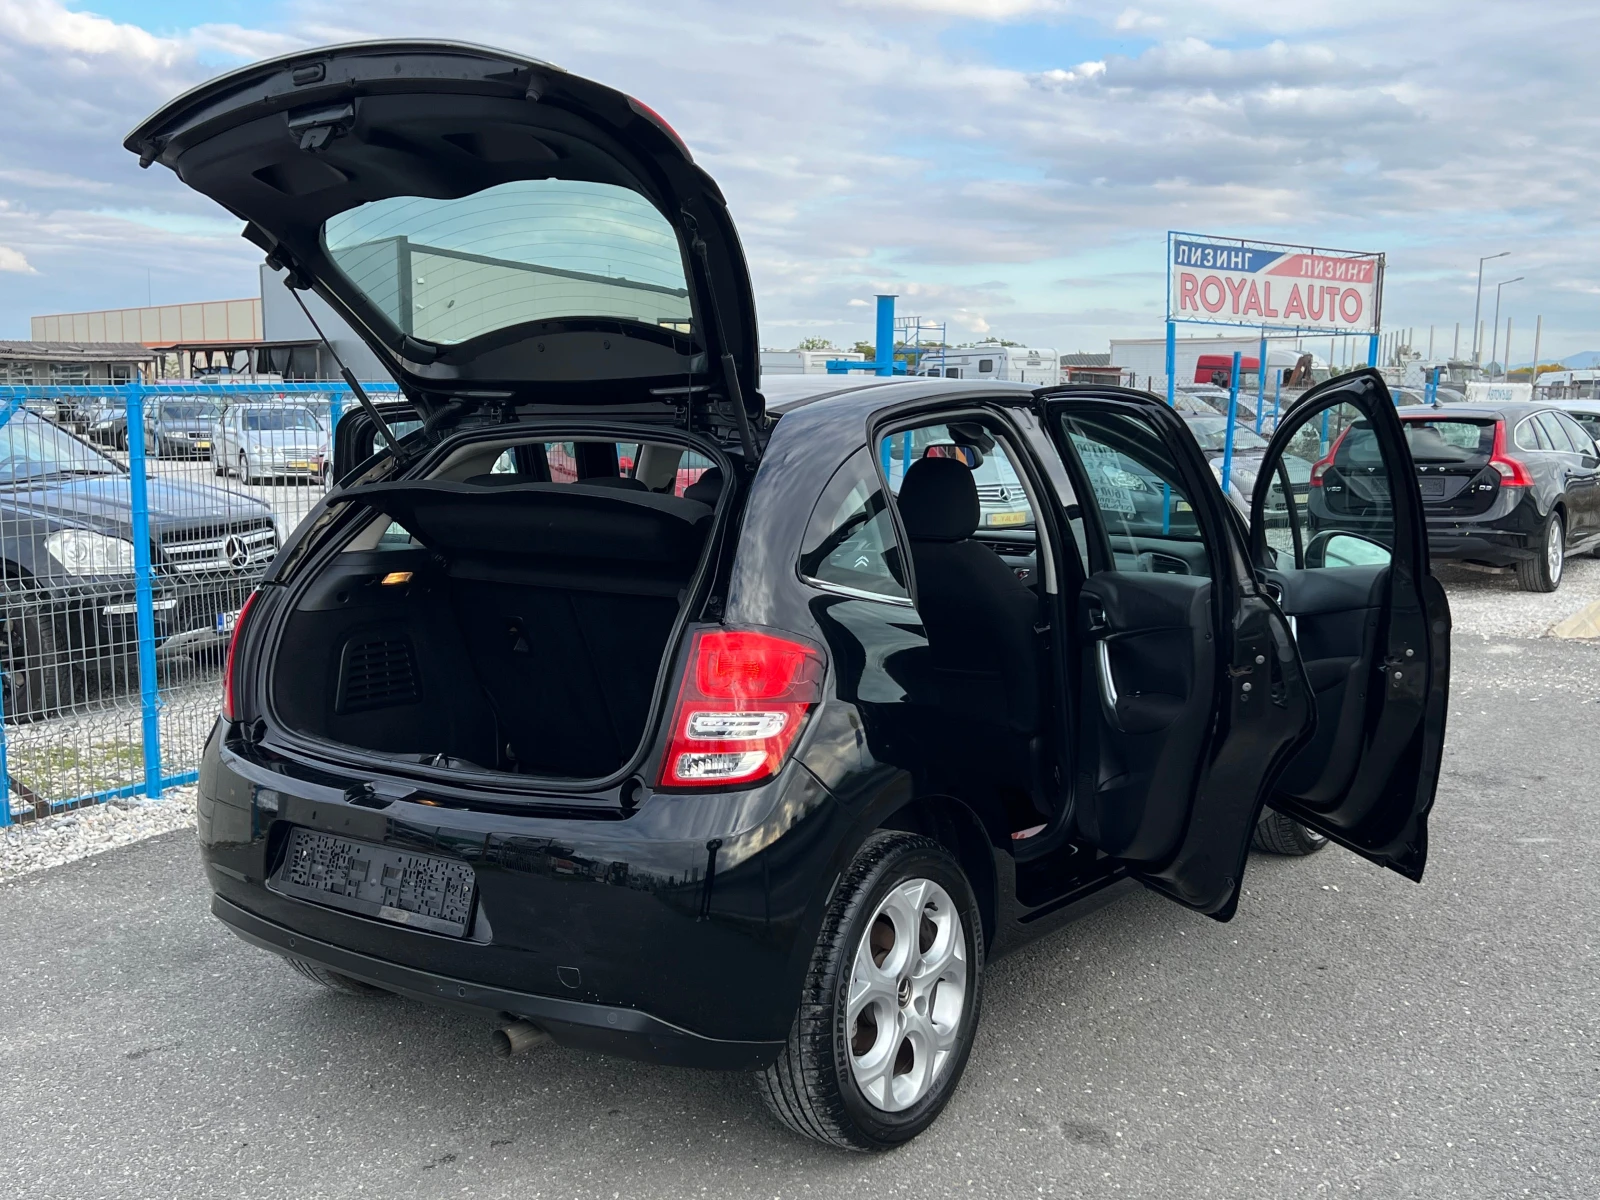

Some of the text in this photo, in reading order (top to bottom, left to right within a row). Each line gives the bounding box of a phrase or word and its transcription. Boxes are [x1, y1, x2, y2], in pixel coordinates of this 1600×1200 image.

[1177, 245, 1253, 270] ЛИЗИНГ
[1300, 258, 1370, 281] ЛИЗИНГ
[1180, 272, 1363, 323] ROYAL AUTO
